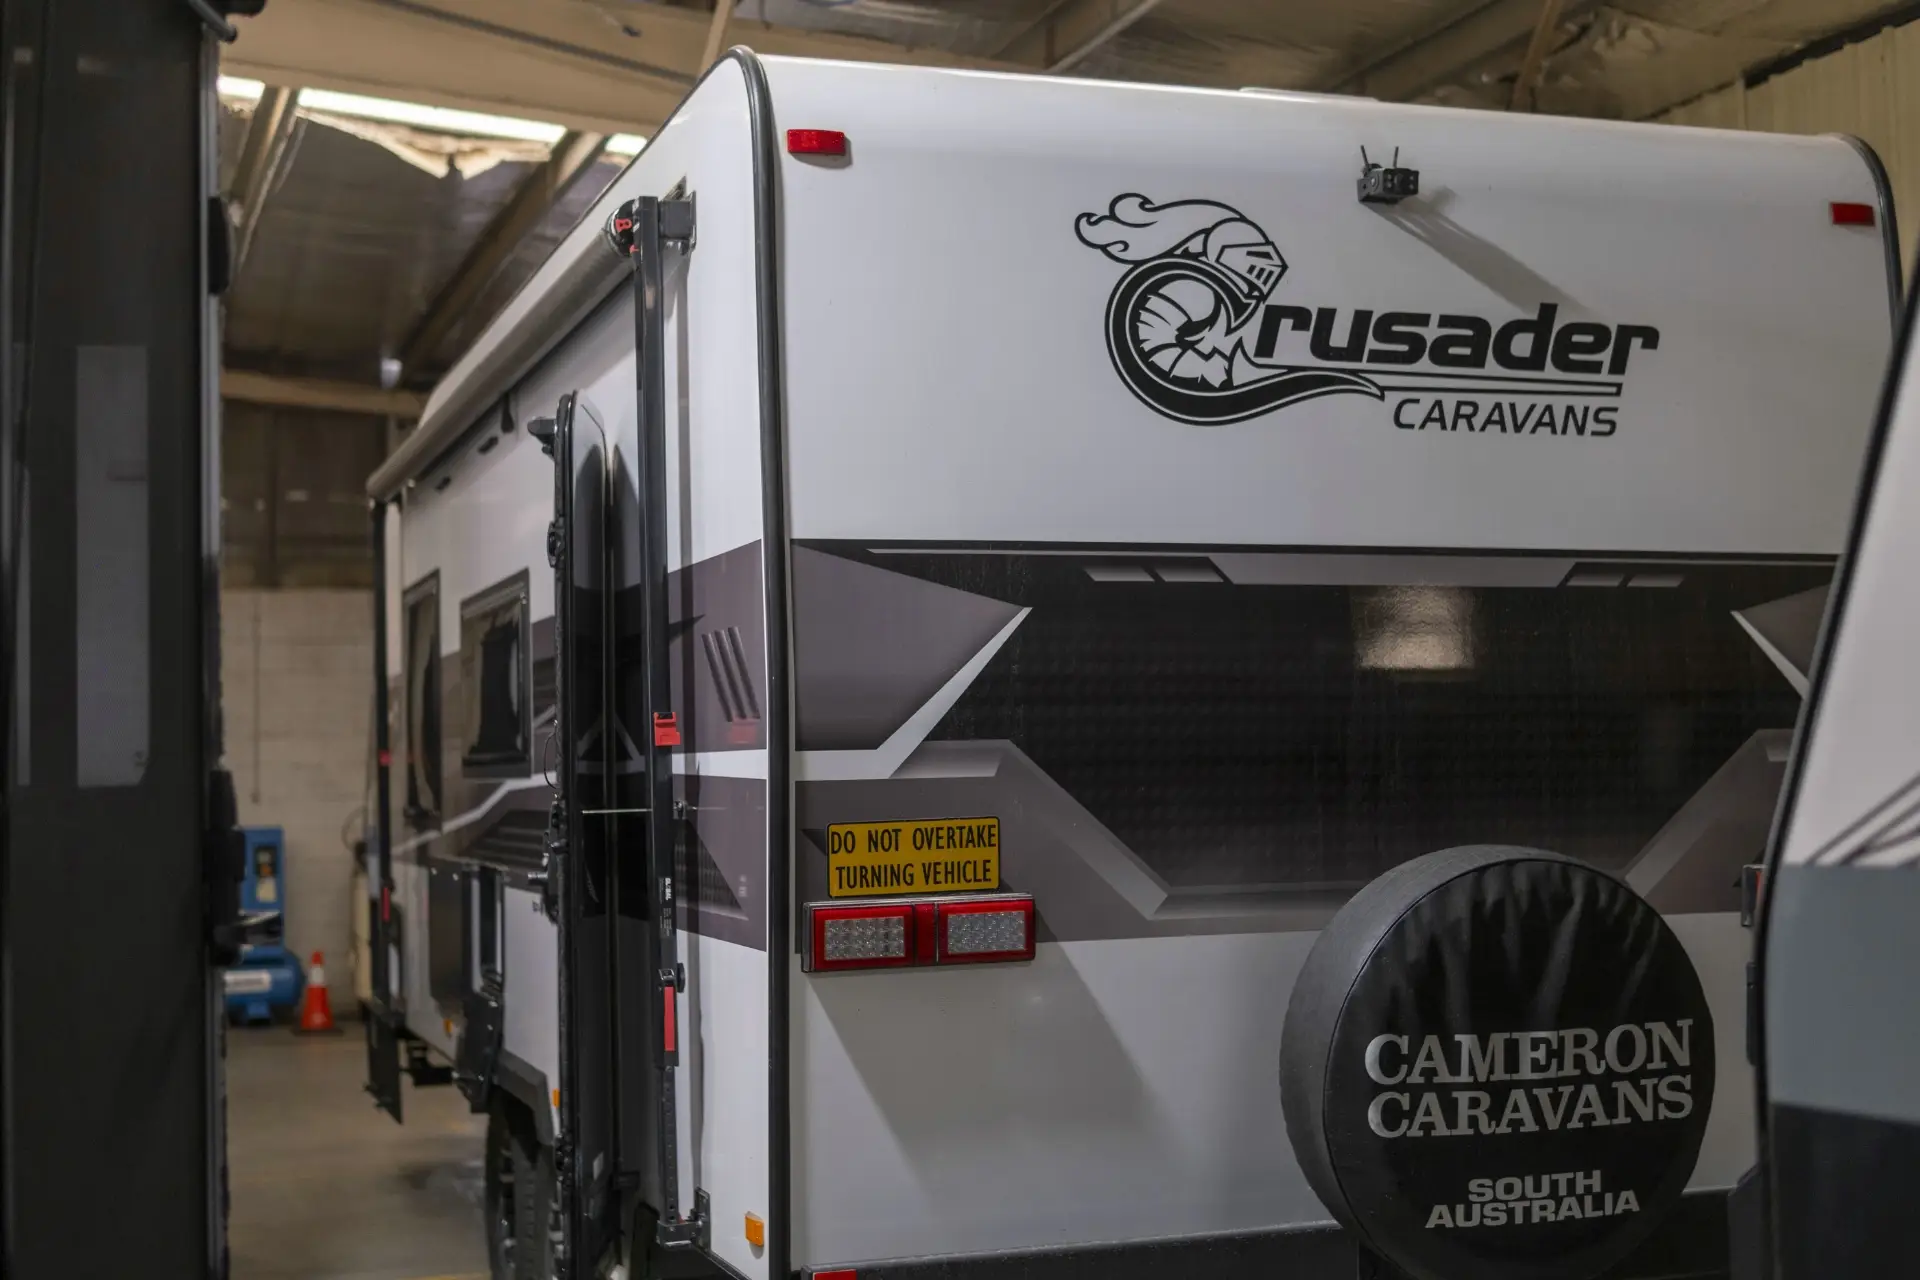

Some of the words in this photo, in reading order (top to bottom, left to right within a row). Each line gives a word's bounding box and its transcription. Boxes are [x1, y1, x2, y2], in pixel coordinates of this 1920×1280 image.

[1393, 398, 1619, 438] CARAVANS
[830, 830, 856, 855] DO
[867, 828, 902, 852] NOT
[912, 824, 997, 851] OVERTAKE
[835, 863, 914, 889] TURNING
[922, 859, 992, 885] VEHICLE
[1364, 1018, 1694, 1085] CAMERON
[1367, 1074, 1693, 1139] CARAVANS
[1468, 1169, 1602, 1202] SOUTH
[1425, 1190, 1640, 1228] AUSTRALIA
